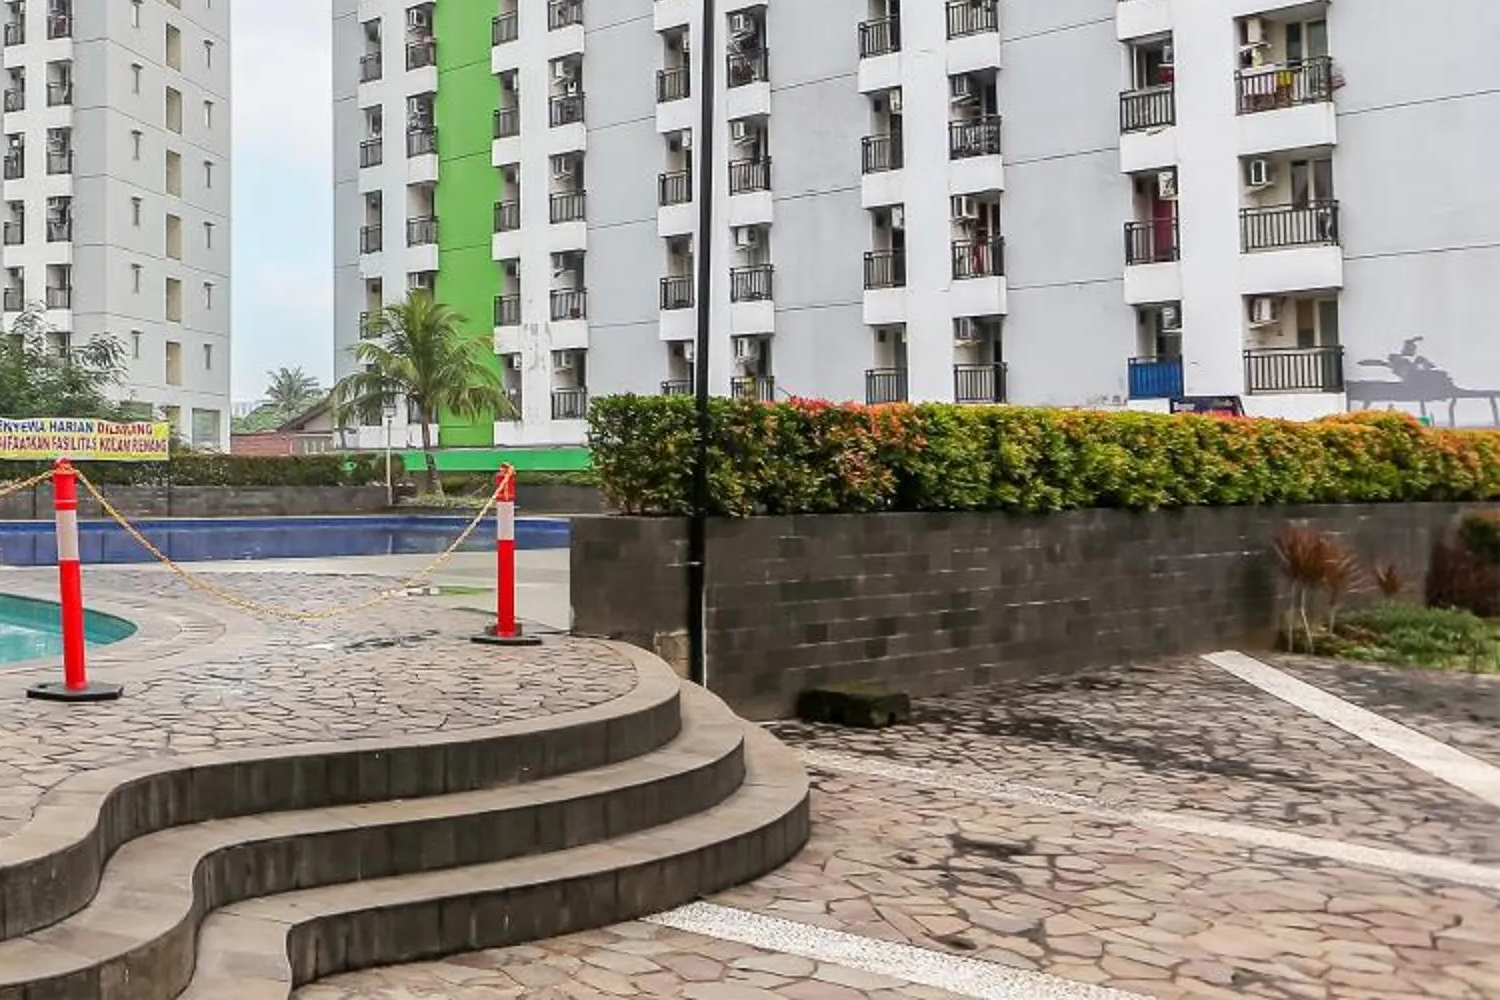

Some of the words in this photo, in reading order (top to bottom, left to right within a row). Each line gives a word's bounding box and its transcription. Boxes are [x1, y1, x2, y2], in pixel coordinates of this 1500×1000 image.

[49, 421, 94, 433] HARIAN
[51, 435, 97, 451] FASILITAS
[99, 437, 131, 452] KOLAM
